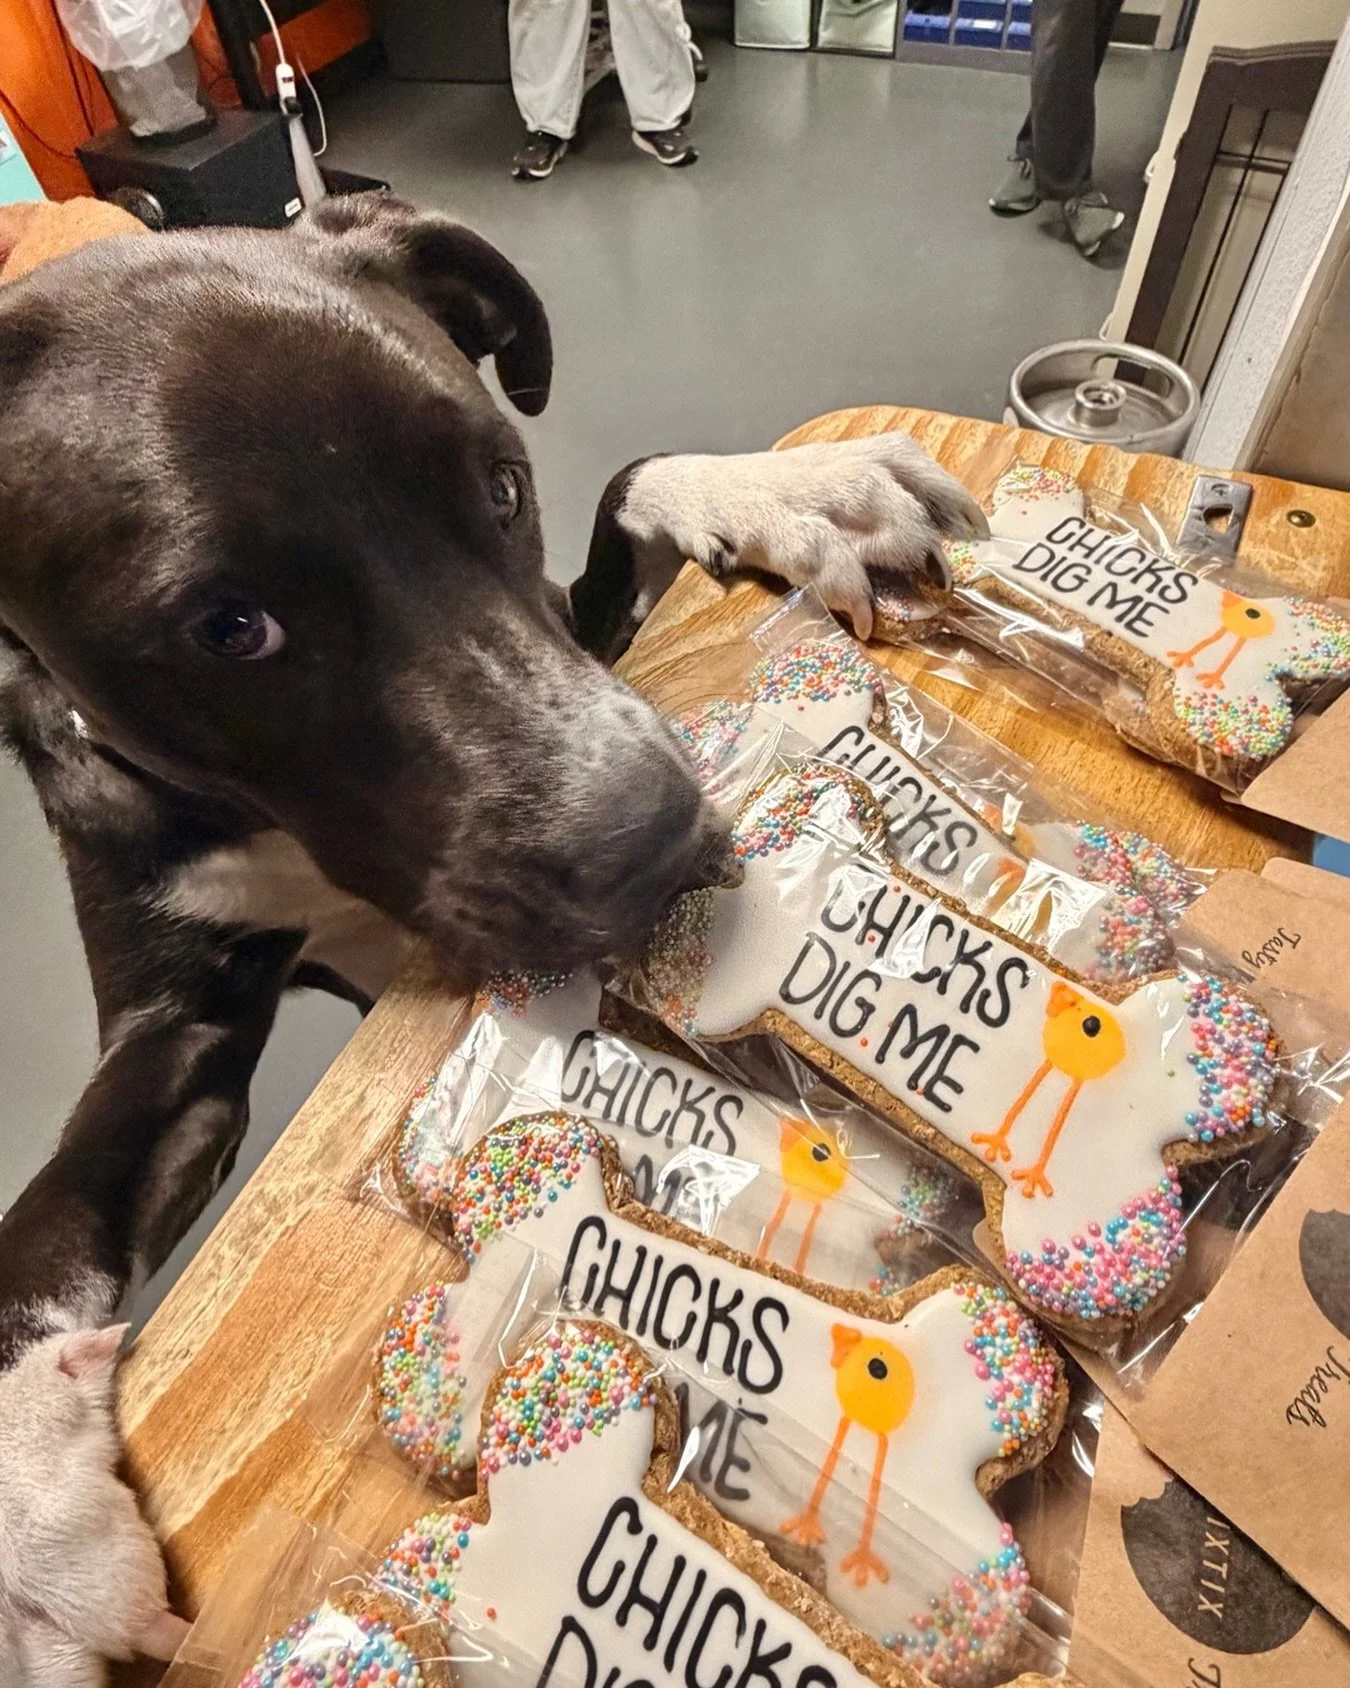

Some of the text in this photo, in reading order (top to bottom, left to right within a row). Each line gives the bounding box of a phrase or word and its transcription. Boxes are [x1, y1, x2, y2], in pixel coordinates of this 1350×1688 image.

[1012, 542, 1170, 638] DIG ME
[1046, 516, 1199, 604] CHICKS
[1241, 927, 1302, 969] Tasty
[779, 932, 980, 1113] DIG ME
[561, 1029, 744, 1157] CHICKS
[561, 1215, 790, 1394] CHICKS
